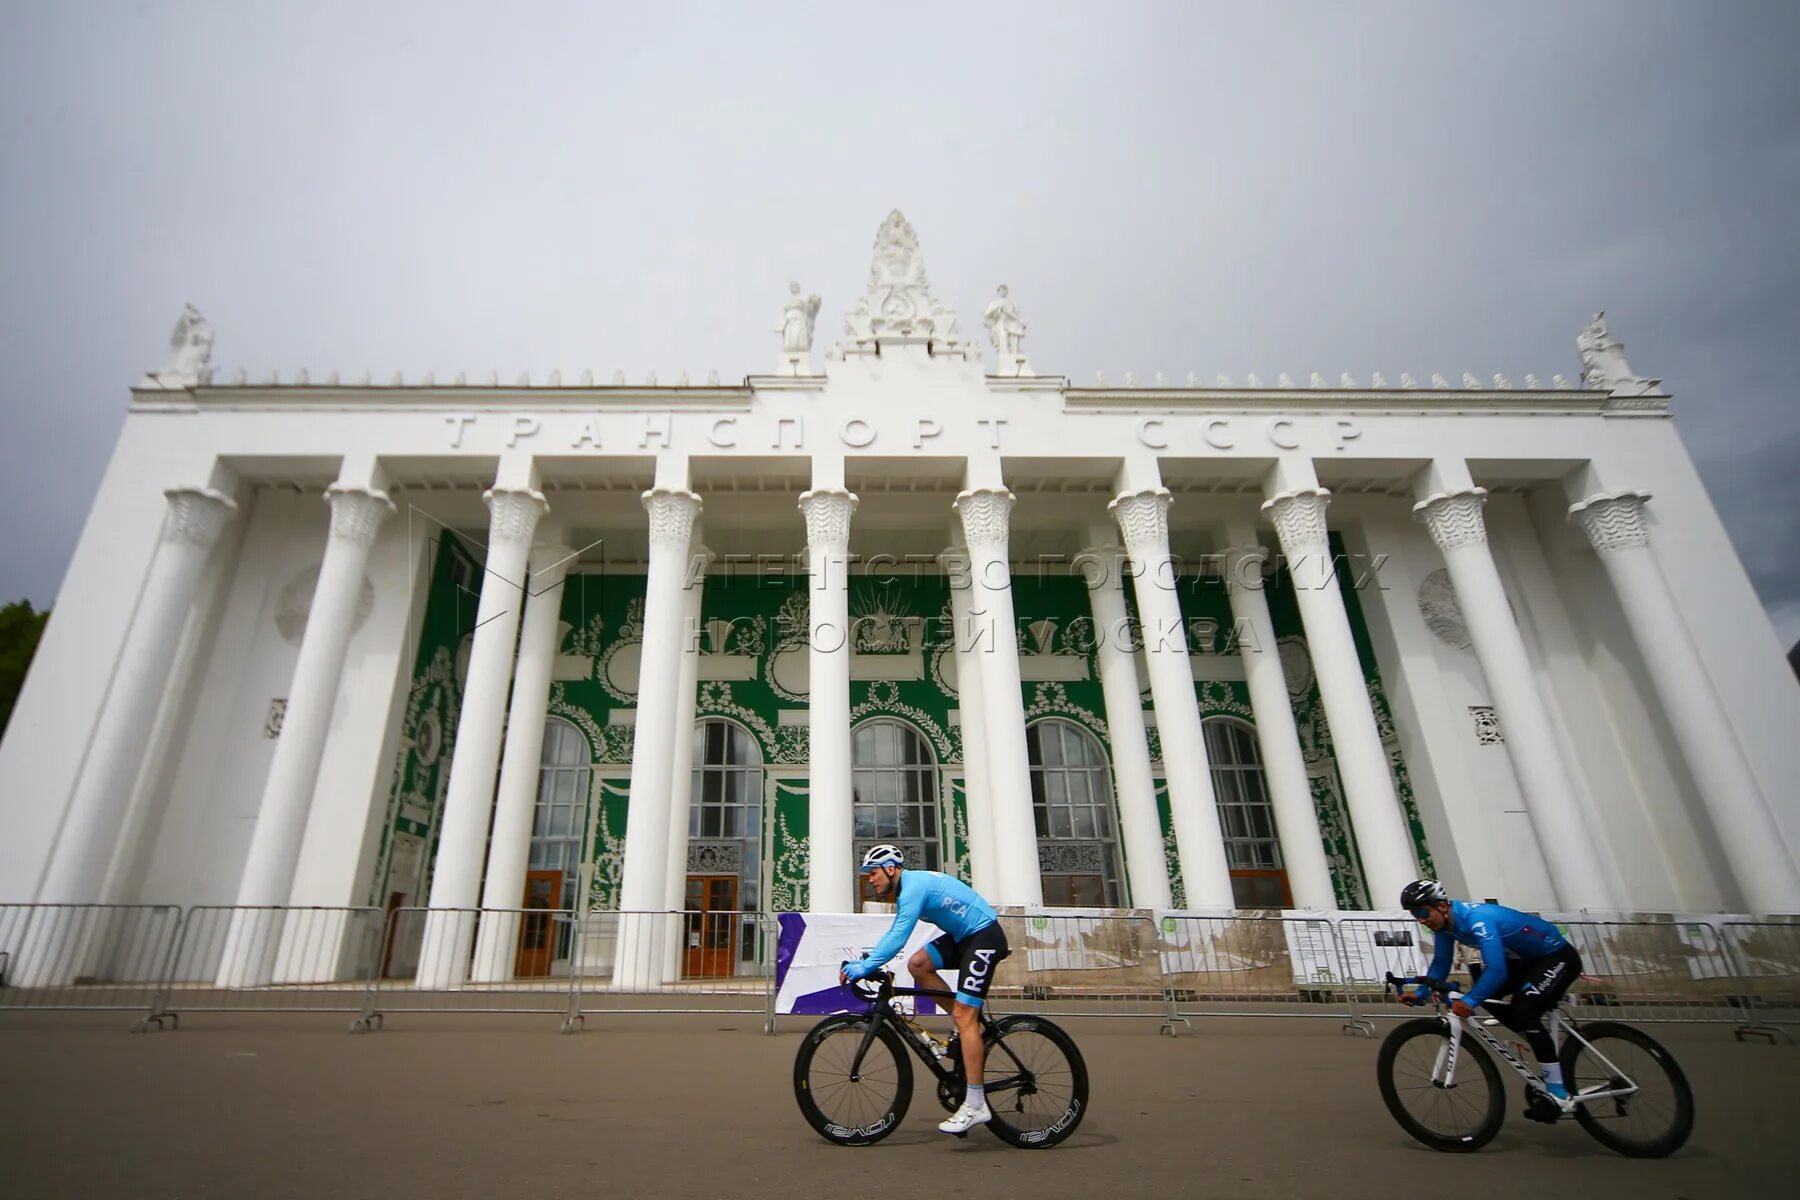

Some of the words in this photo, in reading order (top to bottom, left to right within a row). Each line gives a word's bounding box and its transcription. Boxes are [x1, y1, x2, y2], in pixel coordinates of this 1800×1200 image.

[444, 416, 1007, 449] ТРАНСПОРТ
[1137, 419, 1362, 451] СССР
[940, 897, 968, 918] RCA
[963, 949, 996, 992] RCA
